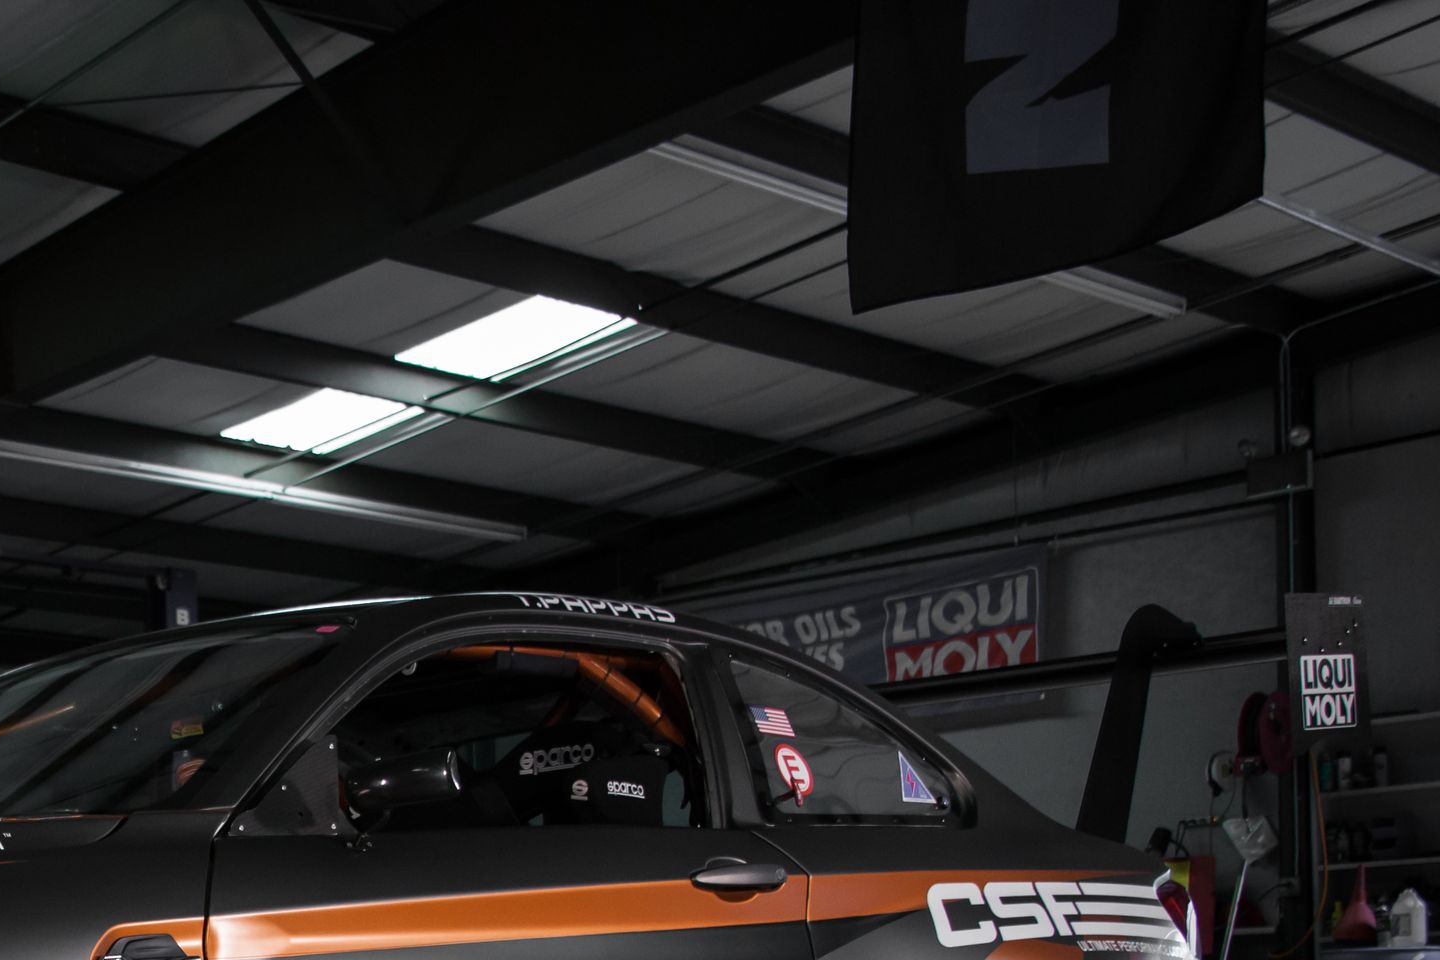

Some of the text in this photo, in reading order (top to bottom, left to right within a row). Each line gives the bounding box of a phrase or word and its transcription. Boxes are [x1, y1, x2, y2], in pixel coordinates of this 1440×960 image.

[793, 605, 862, 645] OILS
[892, 575, 1030, 643] LIQUI
[894, 629, 1035, 684] MOLY
[1304, 658, 1353, 690] LIQUI
[1304, 693, 1355, 727] MOLY
[926, 881, 1083, 948] CSF
